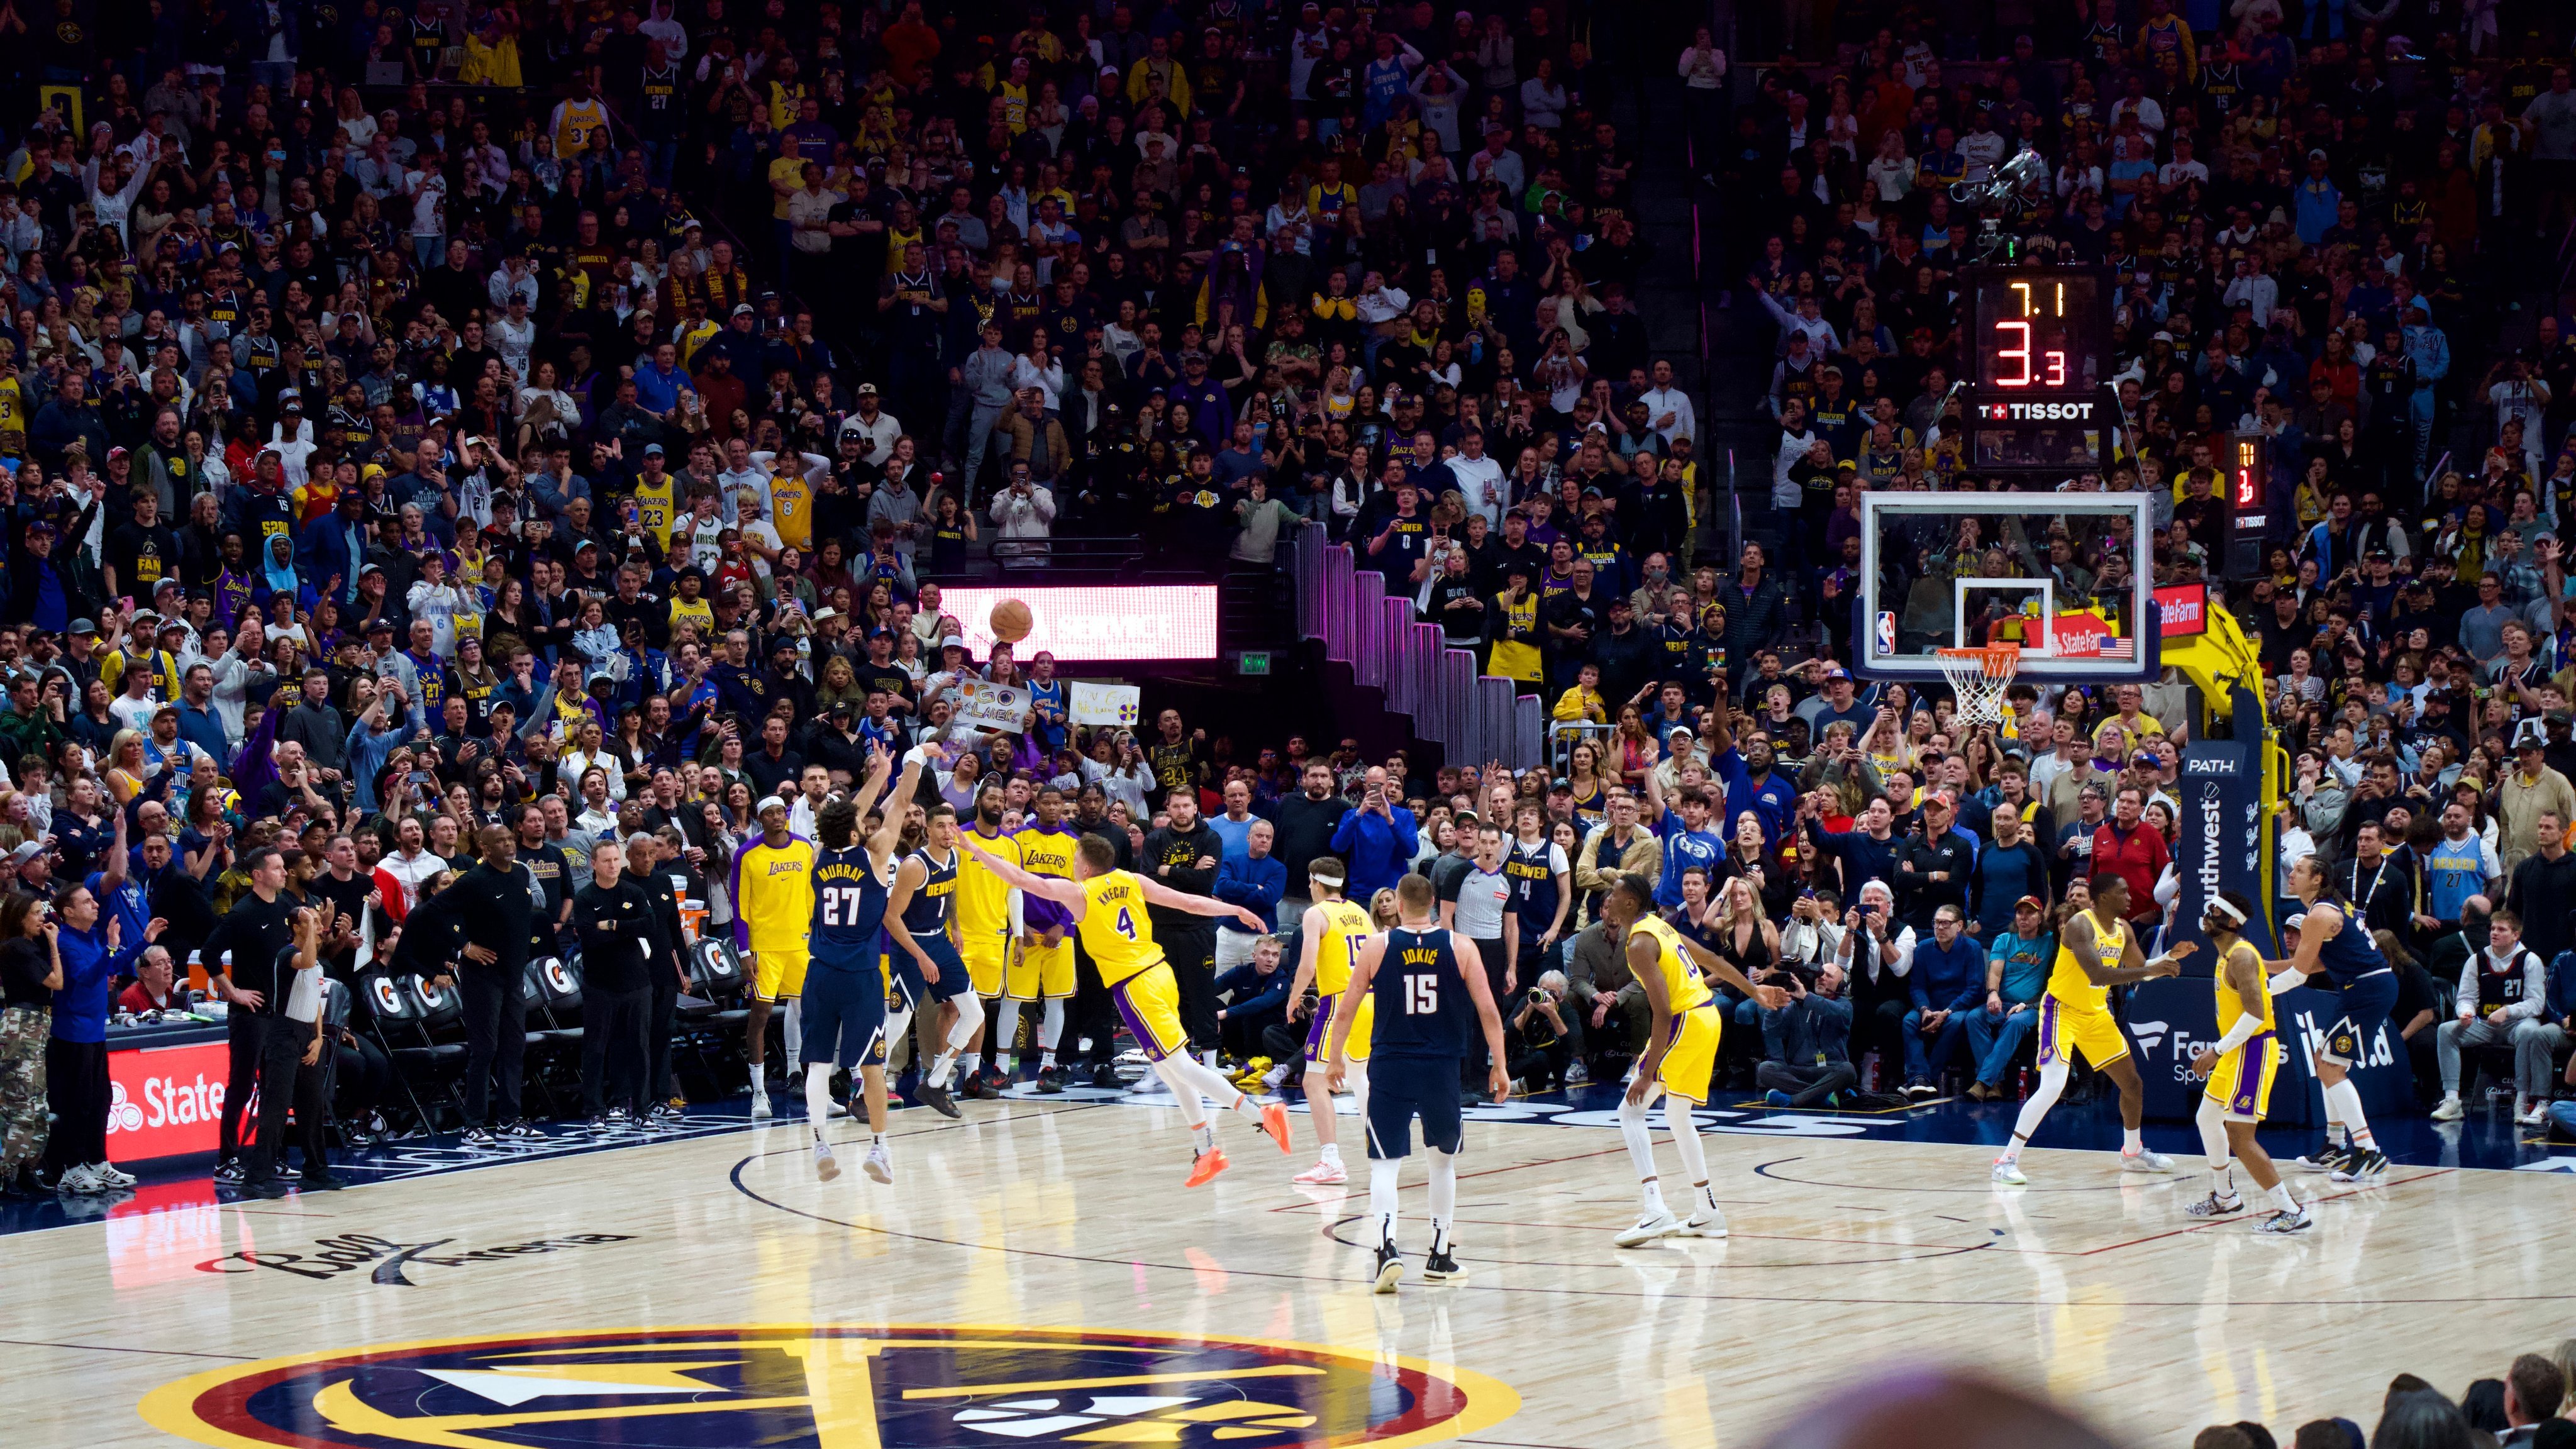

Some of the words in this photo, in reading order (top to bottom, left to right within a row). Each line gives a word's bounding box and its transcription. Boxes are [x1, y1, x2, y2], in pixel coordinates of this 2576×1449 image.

[652, 95, 667, 109] 27
[2216, 94, 2229, 109] 15
[2012, 283, 2063, 316] 7.1
[1995, 321, 2065, 386] 3.3
[518, 358, 528, 370] 15
[2011, 404, 2094, 419] TISSOT
[474, 497, 486, 511] 27
[638, 495, 669, 508] LAKERS
[774, 489, 802, 504] LAKERS
[783, 501, 792, 516] 8
[643, 510, 664, 527] 23
[2245, 516, 2266, 528] TISSOT
[937, 530, 962, 540] NUGGETS
[1398, 523, 1423, 533] NVER
[137, 557, 162, 572] FAN
[2161, 598, 2200, 625] ateFarm
[437, 618, 444, 630] 6
[1245, 655, 1267, 672] EXIT
[426, 683, 440, 699] 27
[468, 686, 492, 700] DENV
[975, 684, 1017, 706] GO
[970, 702, 1018, 724] LAKERS
[1163, 767, 1187, 787] 24
[526, 858, 561, 873] Lakers
[1024, 848, 1068, 869] LAKERS
[2432, 857, 2477, 872] DENVER
[767, 860, 803, 877] LAKERS
[818, 863, 866, 882] MURRAY
[1506, 861, 1548, 880] DENVER
[2446, 872, 2460, 889] 27
[1097, 886, 1130, 906] KNECHT
[1519, 880, 1531, 901] 4
[823, 887, 862, 926] 27
[938, 896, 946, 918] 1
[1116, 906, 1137, 941] 4
[1340, 914, 1363, 930] REAVES
[704, 941, 731, 975] G
[1402, 948, 1438, 966] JOKIĆ
[545, 957, 572, 994] G
[1403, 974, 1438, 1015] 15
[2504, 979, 2523, 997] 27
[144, 1074, 225, 1128] State
